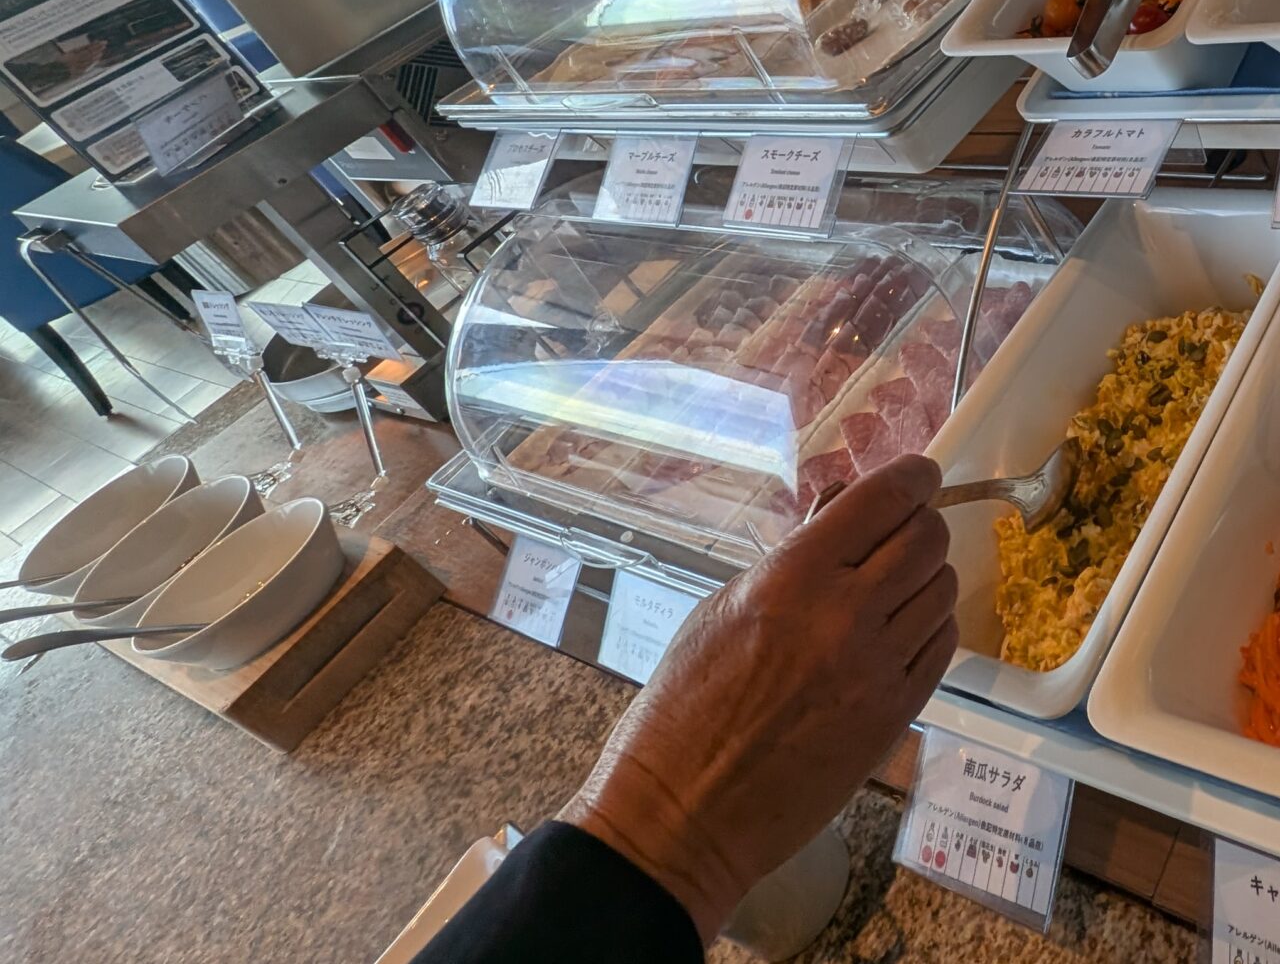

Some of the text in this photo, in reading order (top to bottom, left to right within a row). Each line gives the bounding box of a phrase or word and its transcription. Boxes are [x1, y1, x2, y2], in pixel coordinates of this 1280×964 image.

[1072, 128, 1145, 139] カラフルトマト
[760, 149, 821, 162] スモークチーズ
[962, 758, 1027, 792] 南瓜サラダ
